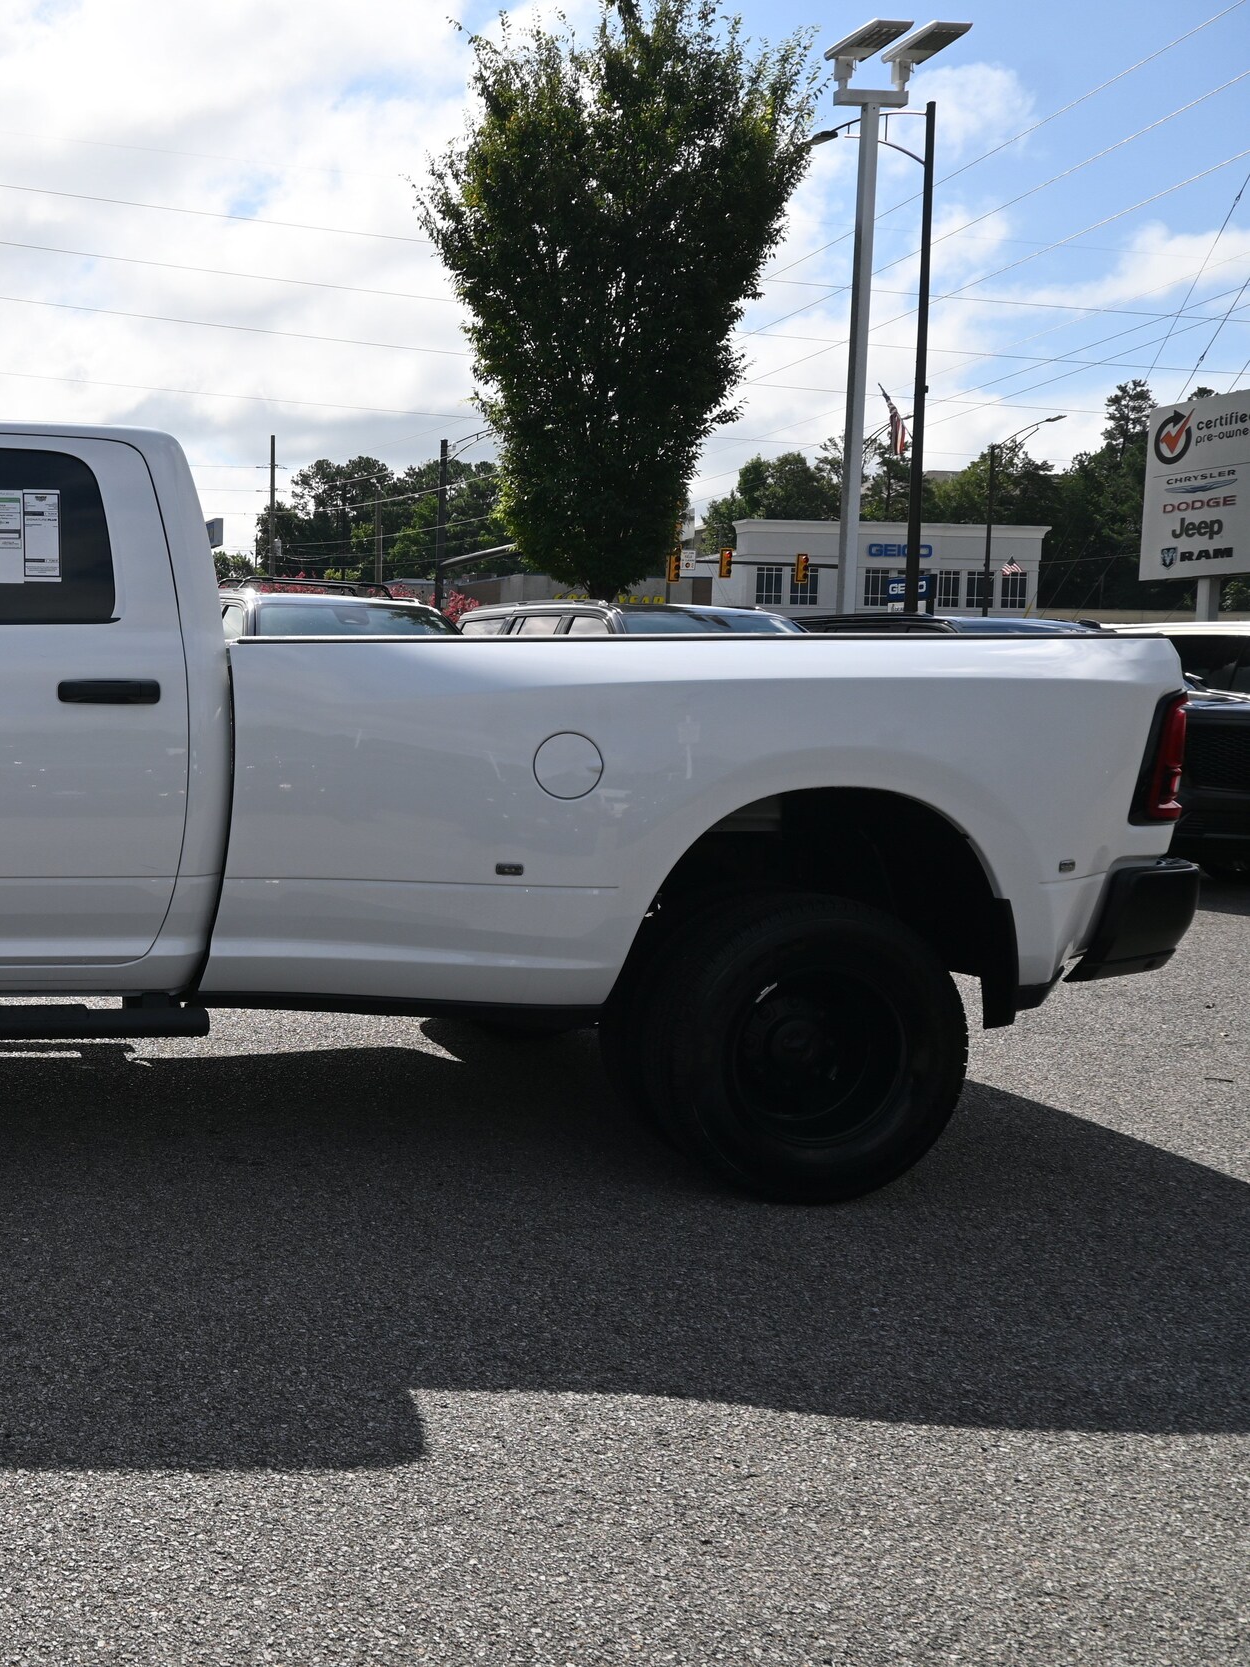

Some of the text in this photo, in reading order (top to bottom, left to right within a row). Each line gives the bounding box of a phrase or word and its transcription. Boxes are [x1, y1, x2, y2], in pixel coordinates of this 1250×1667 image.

[1196, 411, 1250, 431] certifie
[1195, 427, 1250, 446] pre-owne
[1166, 469, 1237, 485] CHRYSLER
[1162, 495, 1237, 514] DODGE
[1171, 517, 1223, 540] Jeep
[1179, 547, 1234, 562] RAM
[888, 580, 927, 595] GEO
